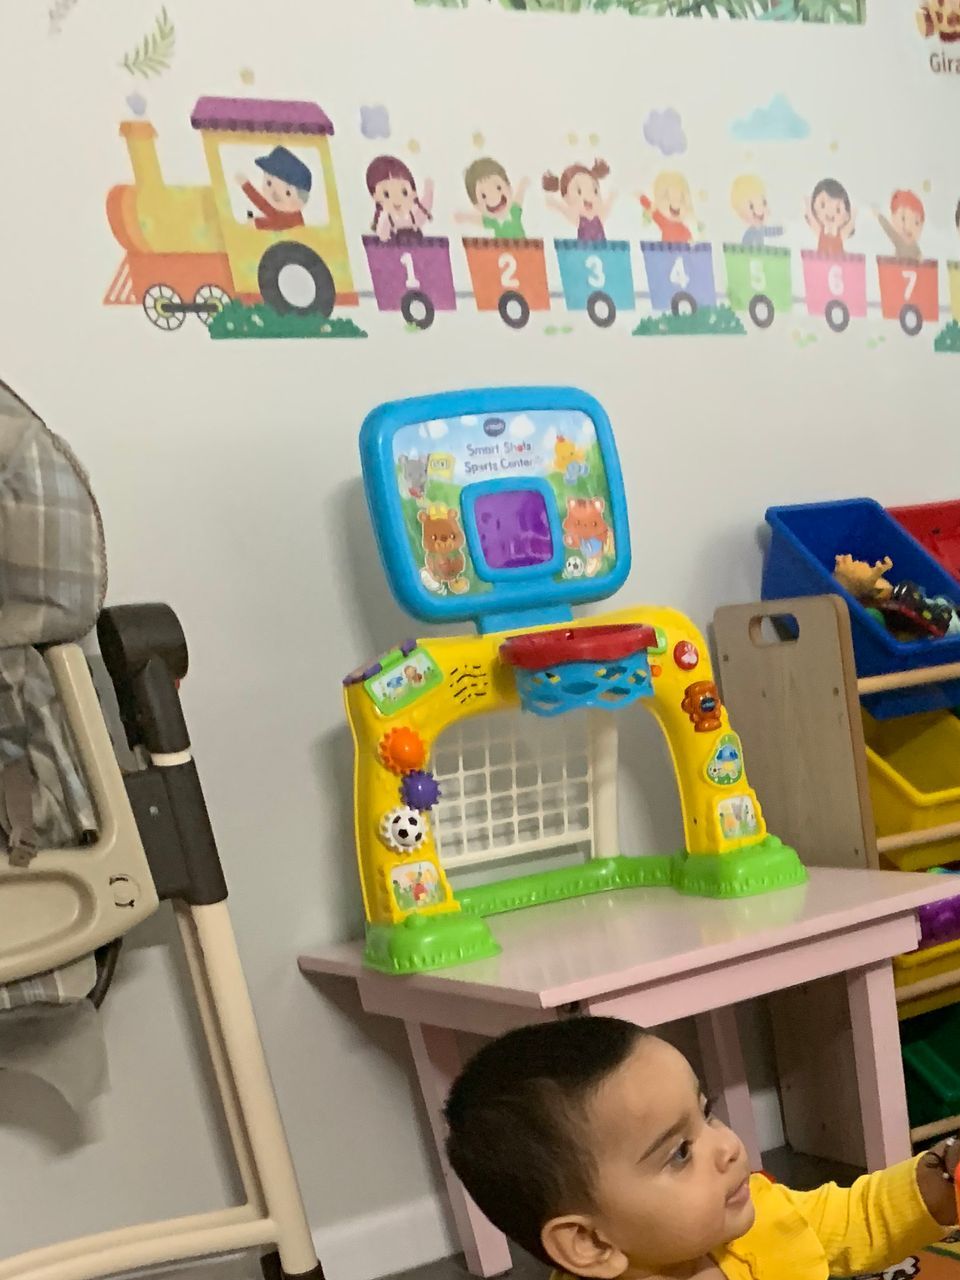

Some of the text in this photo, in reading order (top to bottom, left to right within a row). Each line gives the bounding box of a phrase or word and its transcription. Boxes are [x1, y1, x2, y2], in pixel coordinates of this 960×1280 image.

[400, 252, 420, 289] 1
[498, 252, 520, 289] 2
[585, 254, 606, 288] 3
[669, 256, 690, 288] 4
[749, 259, 766, 292] 5
[827, 265, 844, 297] 6
[901, 269, 918, 301] 7
